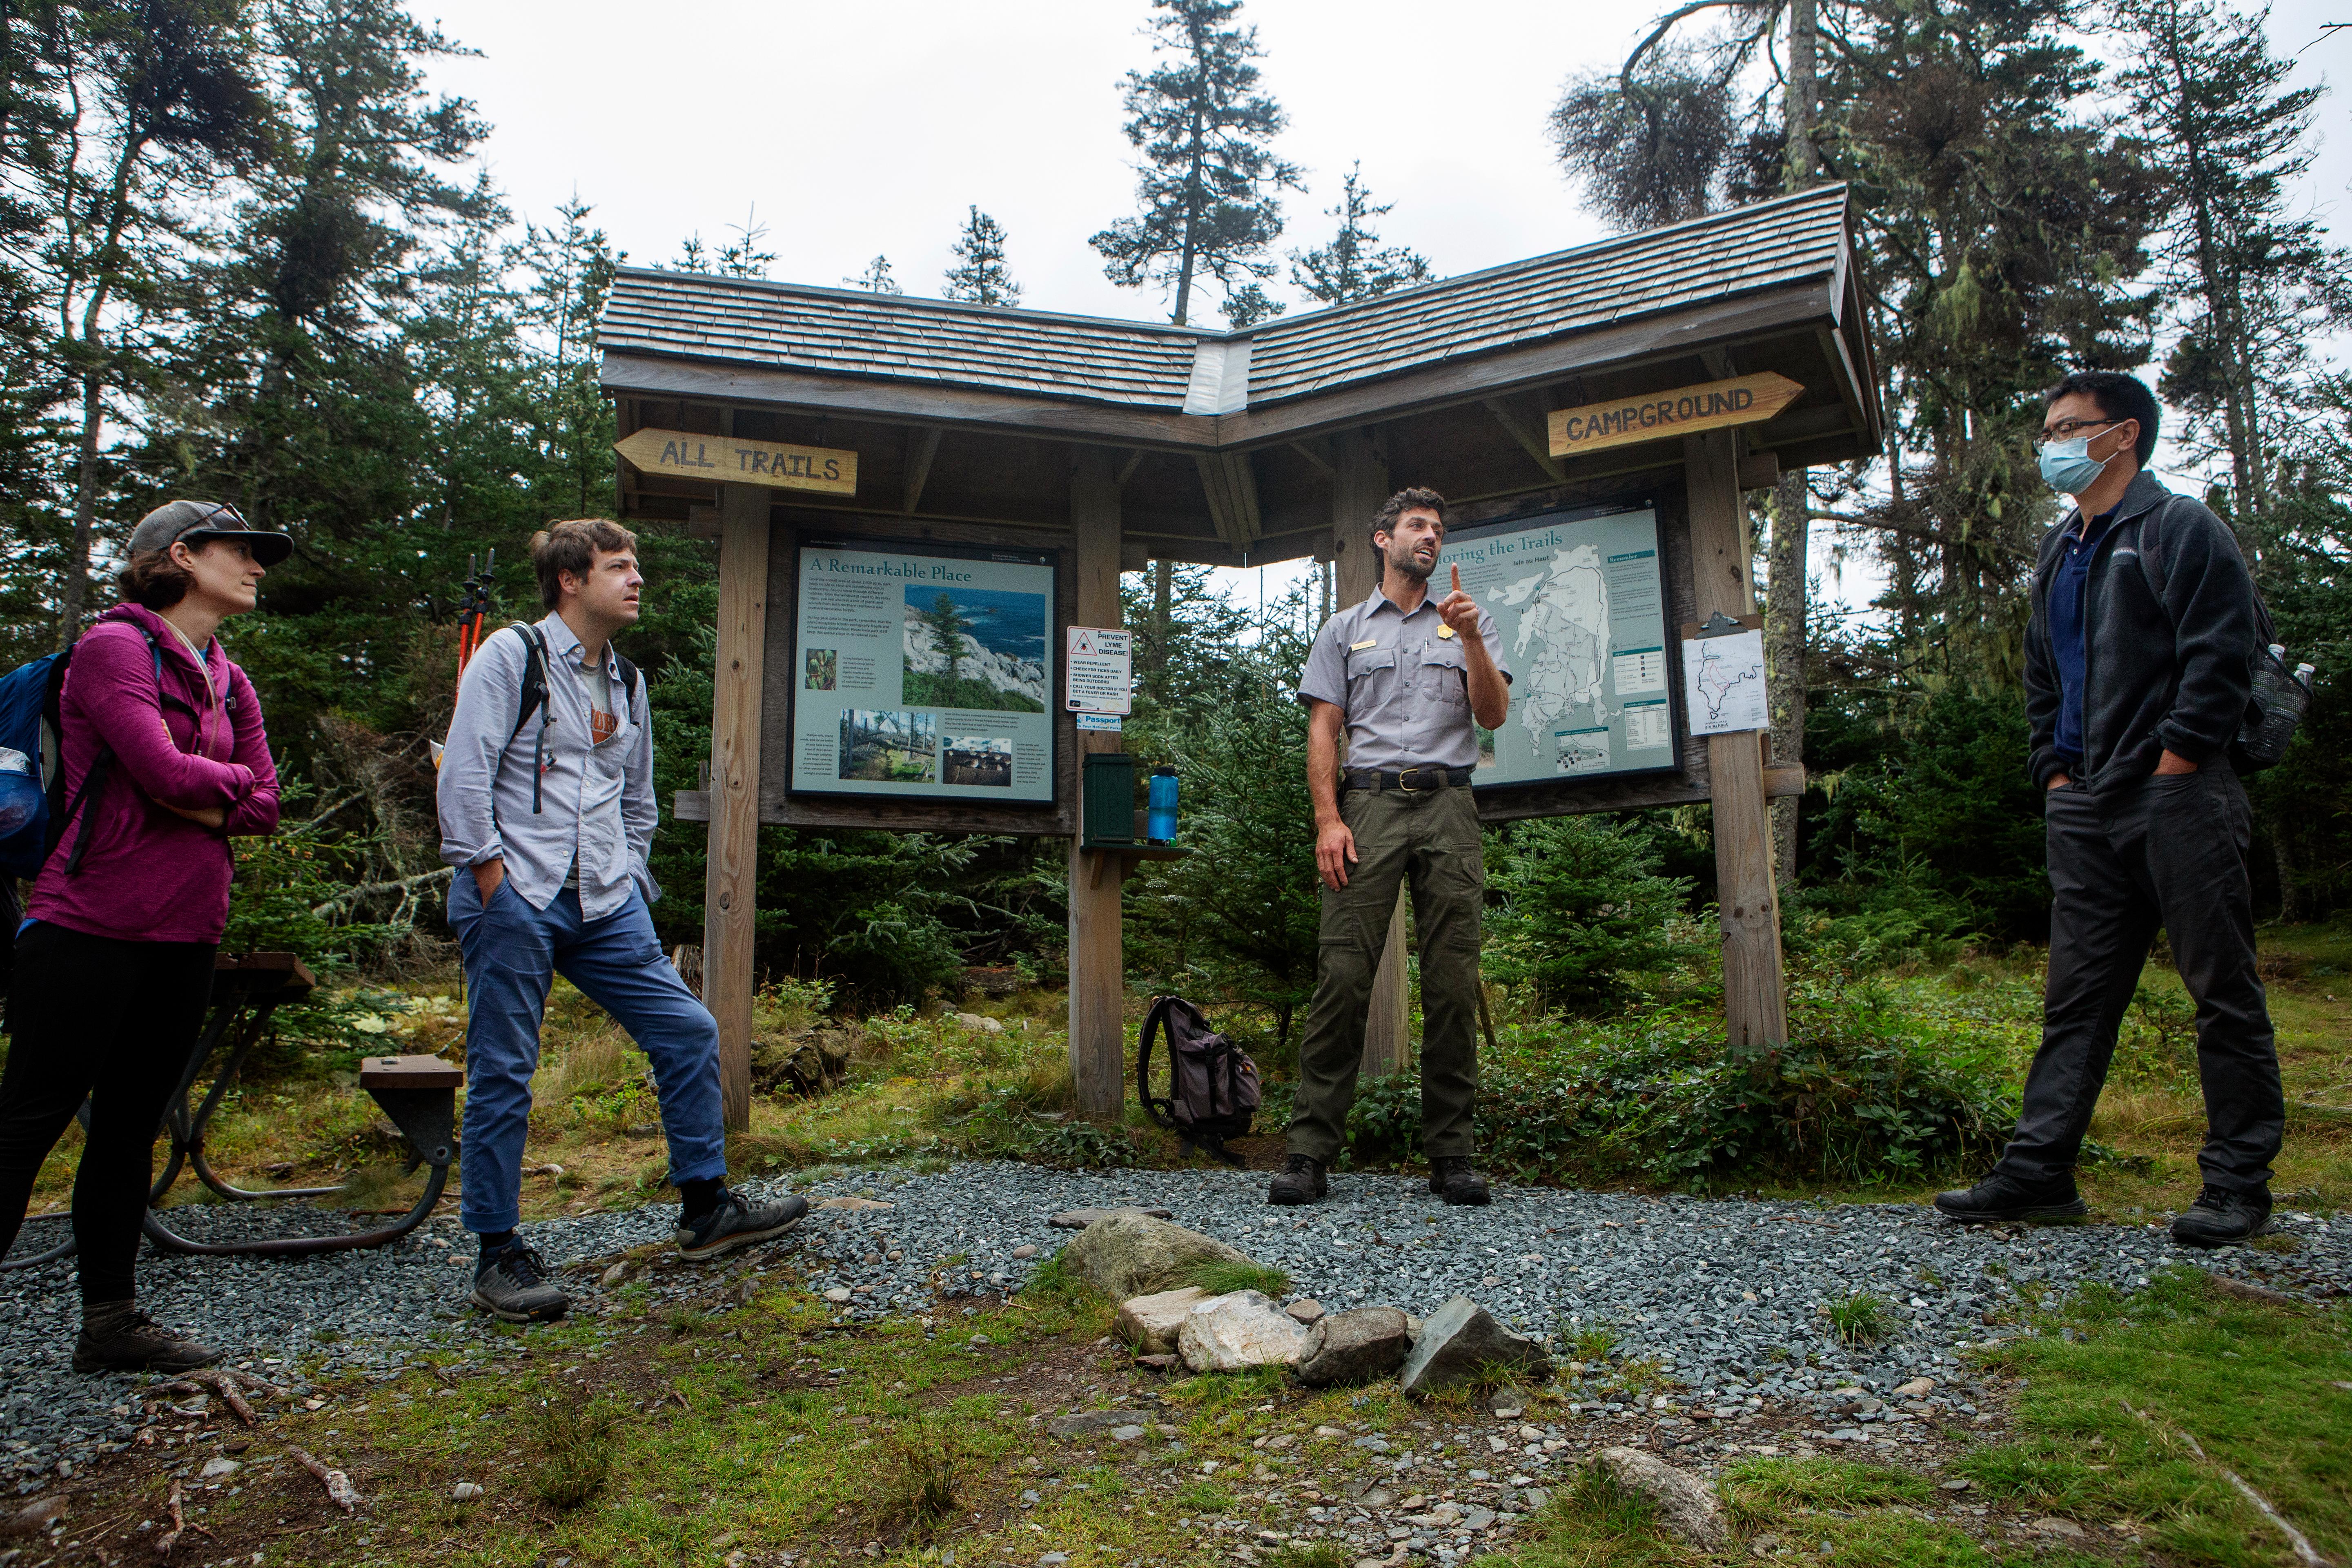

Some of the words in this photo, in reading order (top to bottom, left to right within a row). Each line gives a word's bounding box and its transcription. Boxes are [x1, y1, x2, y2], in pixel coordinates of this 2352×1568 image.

[1566, 388, 1753, 441] CAMPGROUND
[659, 441, 715, 468] ALL
[735, 449, 840, 481] TRAILS
[1438, 548, 1485, 564] loring
[1489, 539, 1514, 556] the
[1518, 530, 1562, 550] Trails
[1610, 554, 1637, 562] Remember
[809, 558, 823, 572] A
[828, 561, 927, 580] Remarkable
[930, 566, 971, 582] Place
[1085, 716, 1120, 724] Passport
